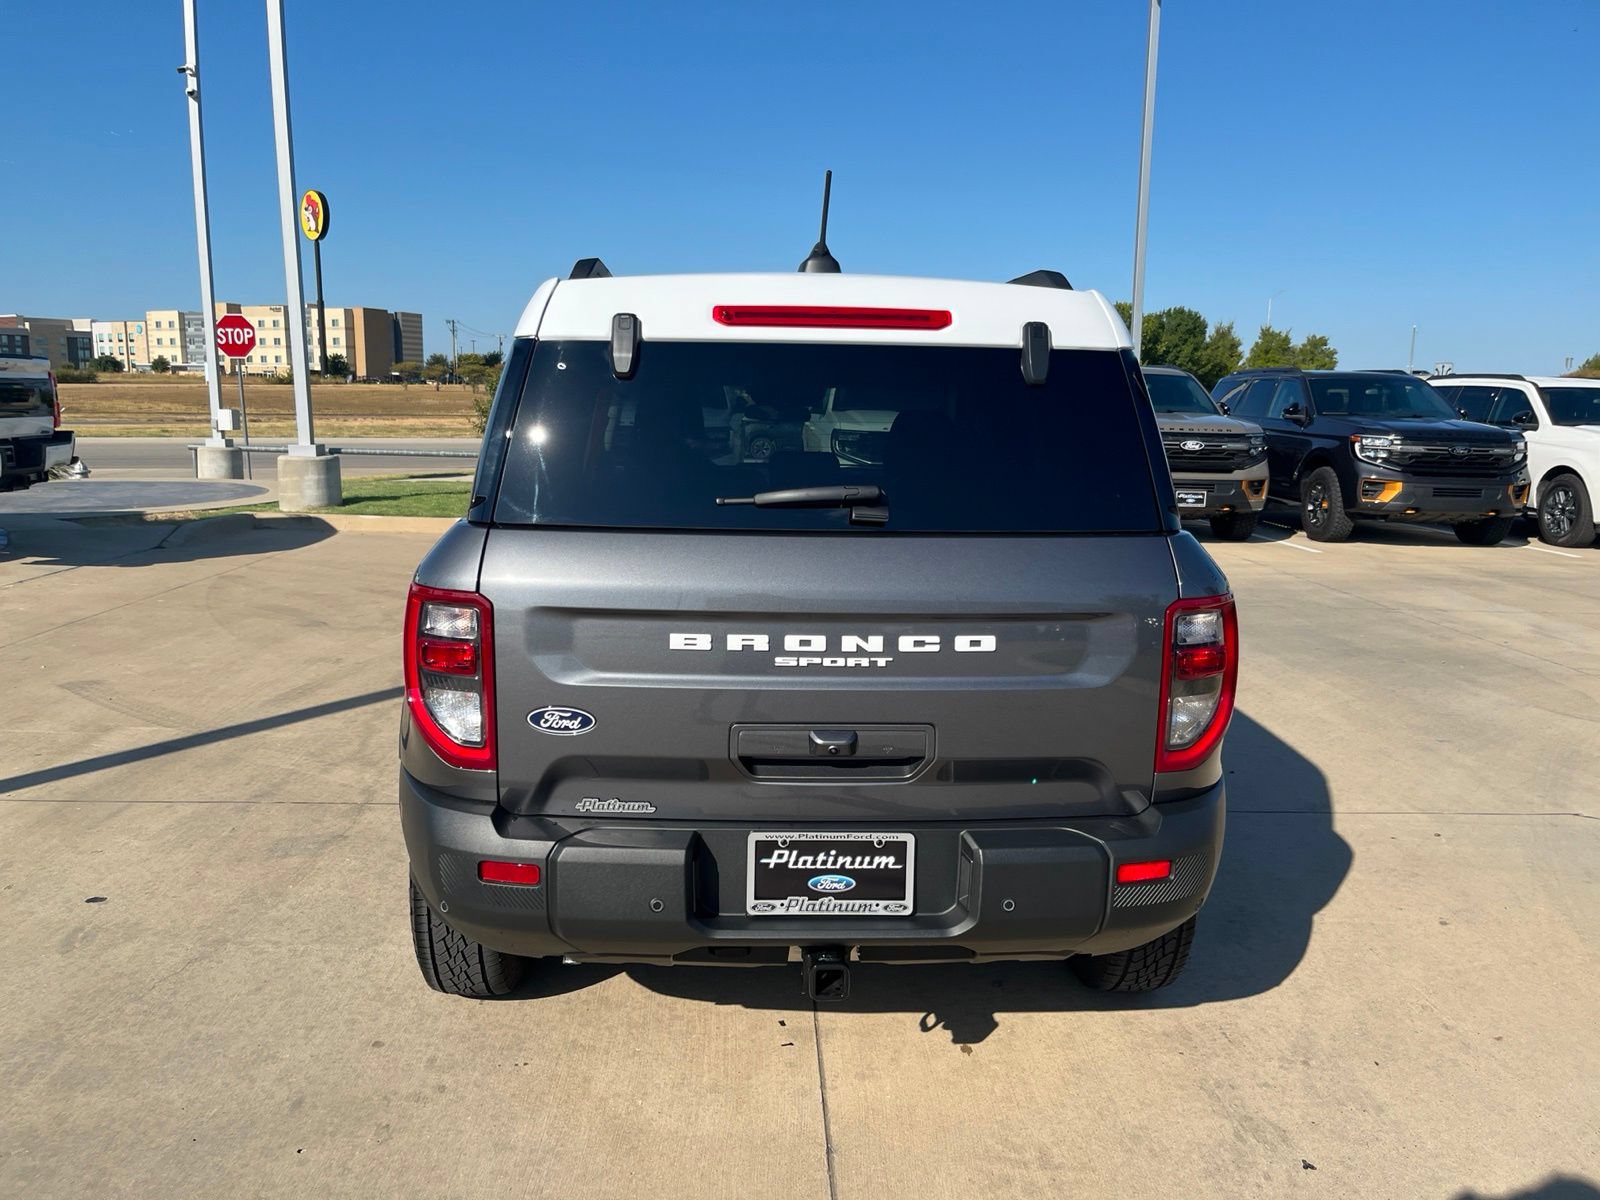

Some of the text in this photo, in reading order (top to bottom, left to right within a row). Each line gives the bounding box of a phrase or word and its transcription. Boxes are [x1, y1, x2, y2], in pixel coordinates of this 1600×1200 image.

[217, 328, 253, 345] STOP
[669, 633, 997, 652] BRONCO
[774, 656, 894, 667] SPORT
[540, 710, 583, 730] Ford
[575, 798, 657, 813] Platinum
[760, 849, 904, 869] Platinum
[816, 877, 847, 890] Ford
[784, 896, 880, 912] Platinum
